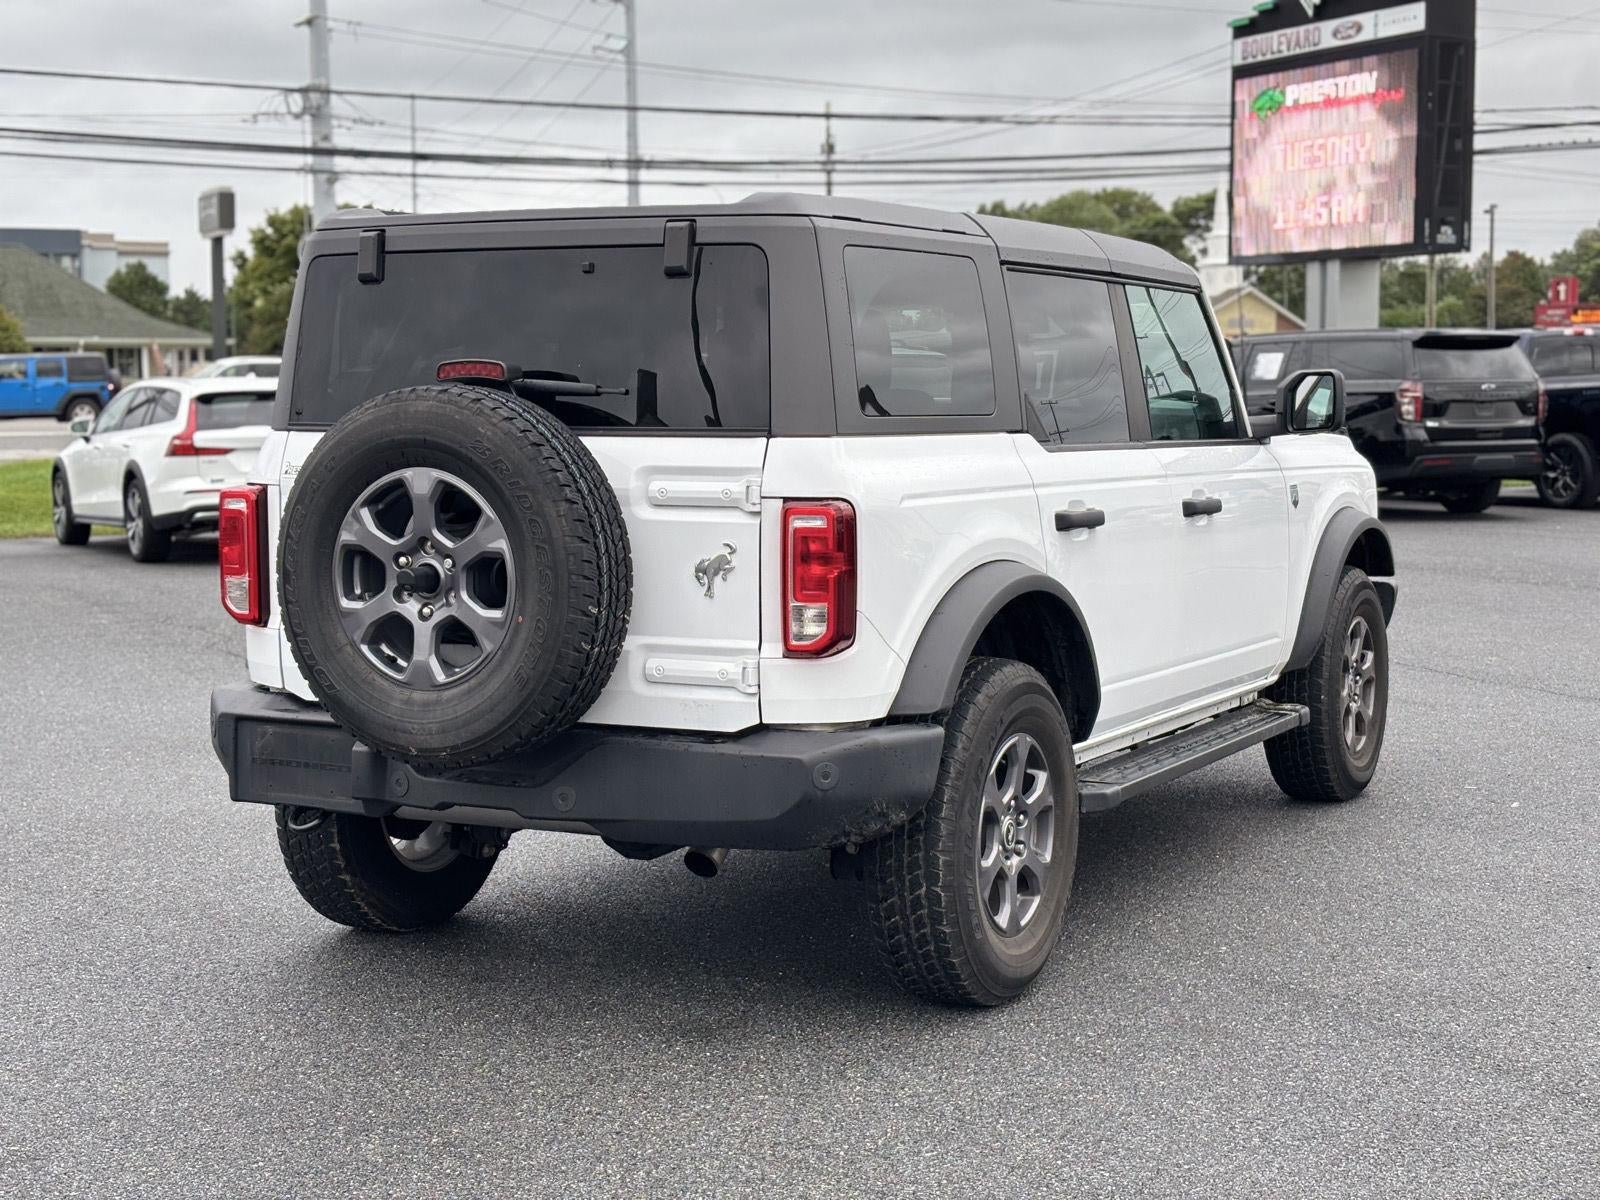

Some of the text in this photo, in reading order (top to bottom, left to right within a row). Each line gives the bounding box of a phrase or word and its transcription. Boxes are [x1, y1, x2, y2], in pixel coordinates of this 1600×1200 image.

[1242, 27, 1321, 60] BOULEVARD
[1285, 71, 1377, 107] PRESTON
[1271, 133, 1372, 172] TUESDAY
[468, 440, 554, 688] BRIDGESTONE
